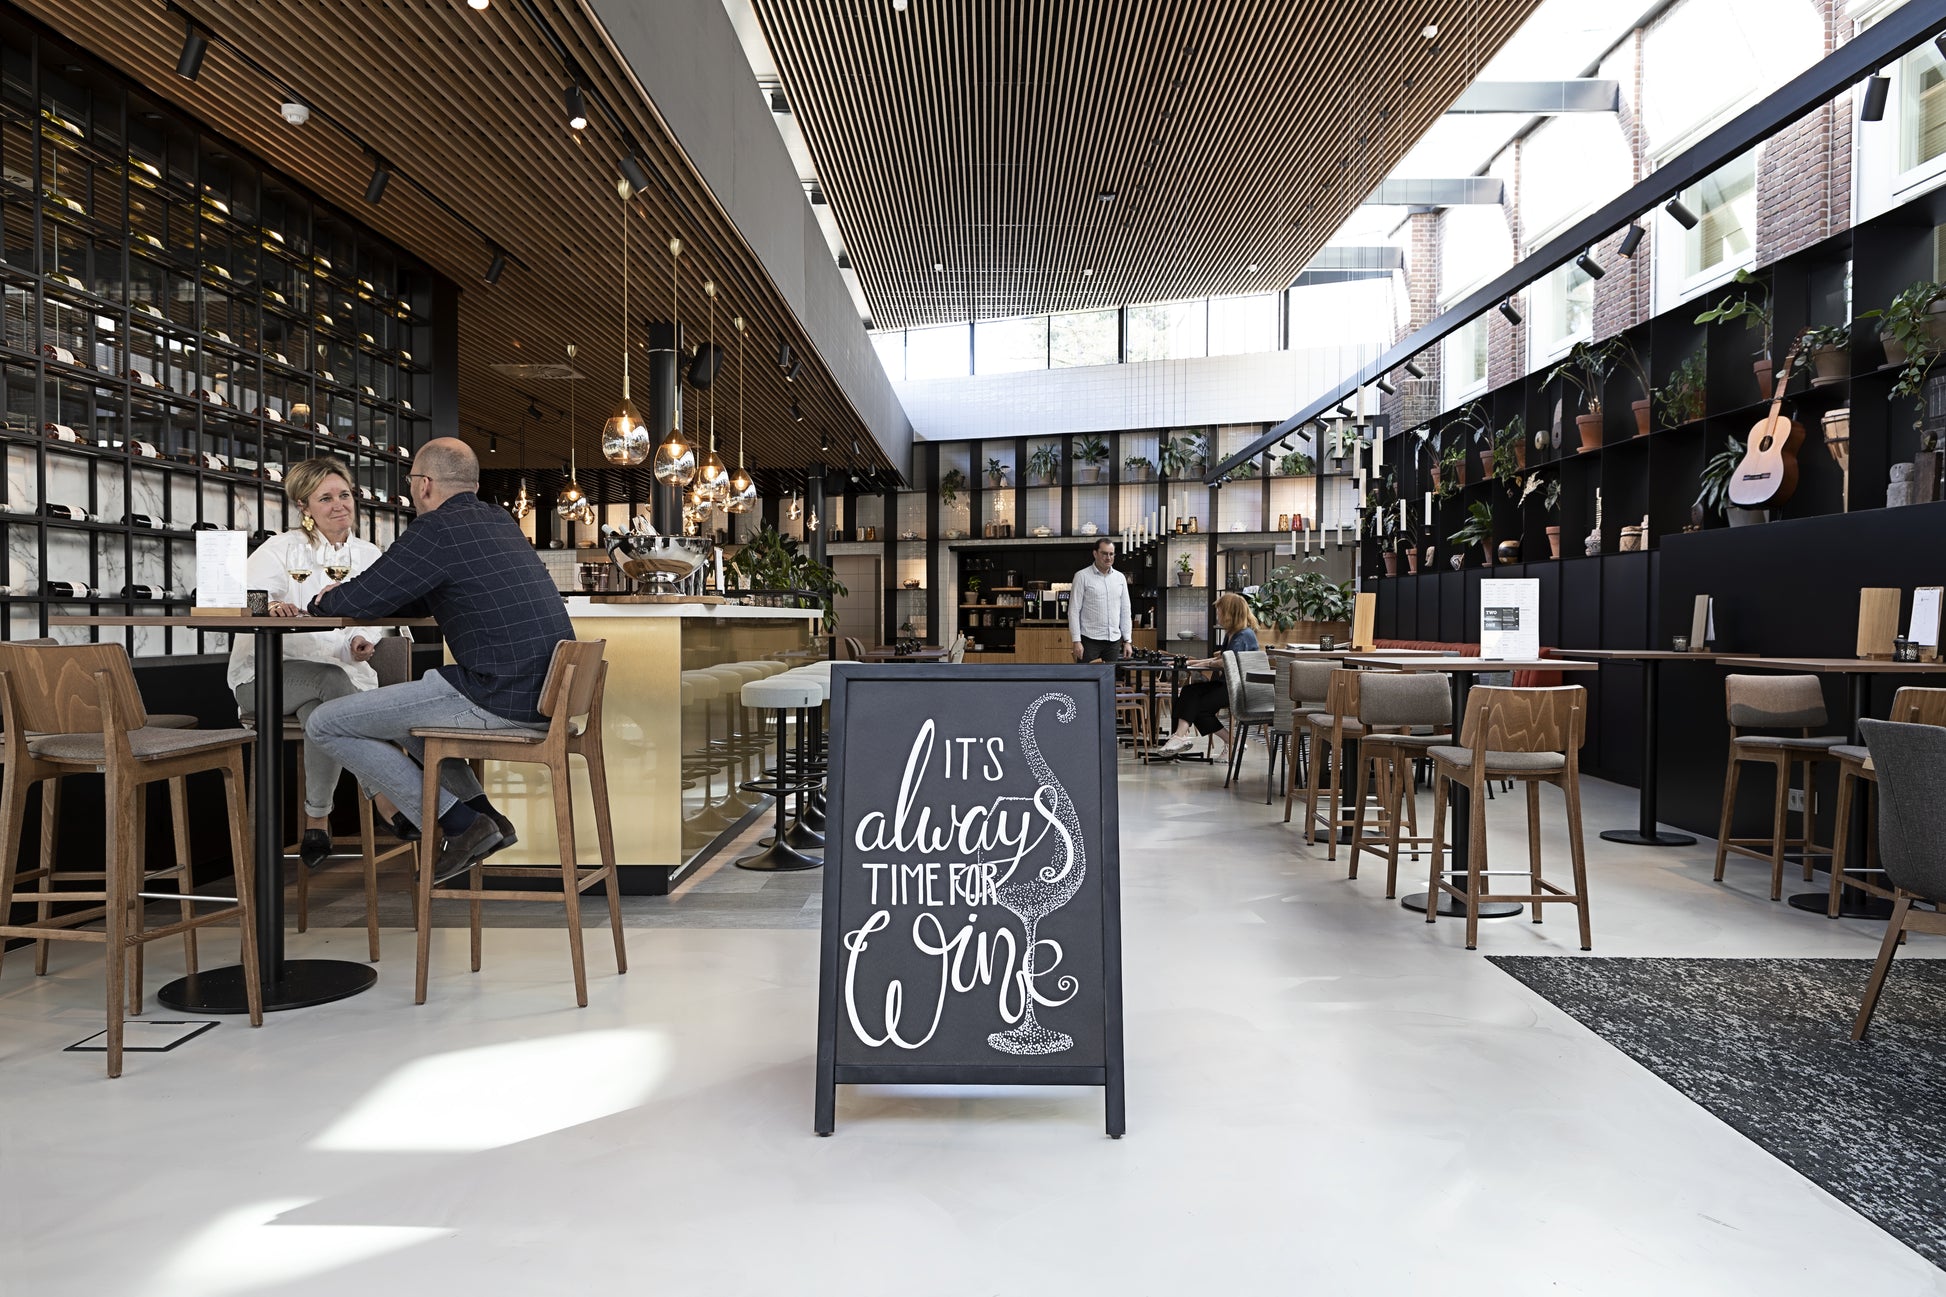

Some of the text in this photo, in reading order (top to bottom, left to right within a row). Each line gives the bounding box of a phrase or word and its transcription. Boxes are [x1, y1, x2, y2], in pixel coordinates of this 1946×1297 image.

[945, 737, 1003, 780] IT'S
[855, 718, 1074, 898] always
[862, 863, 998, 907] TIME FOR
[844, 910, 1079, 1050] Wine
